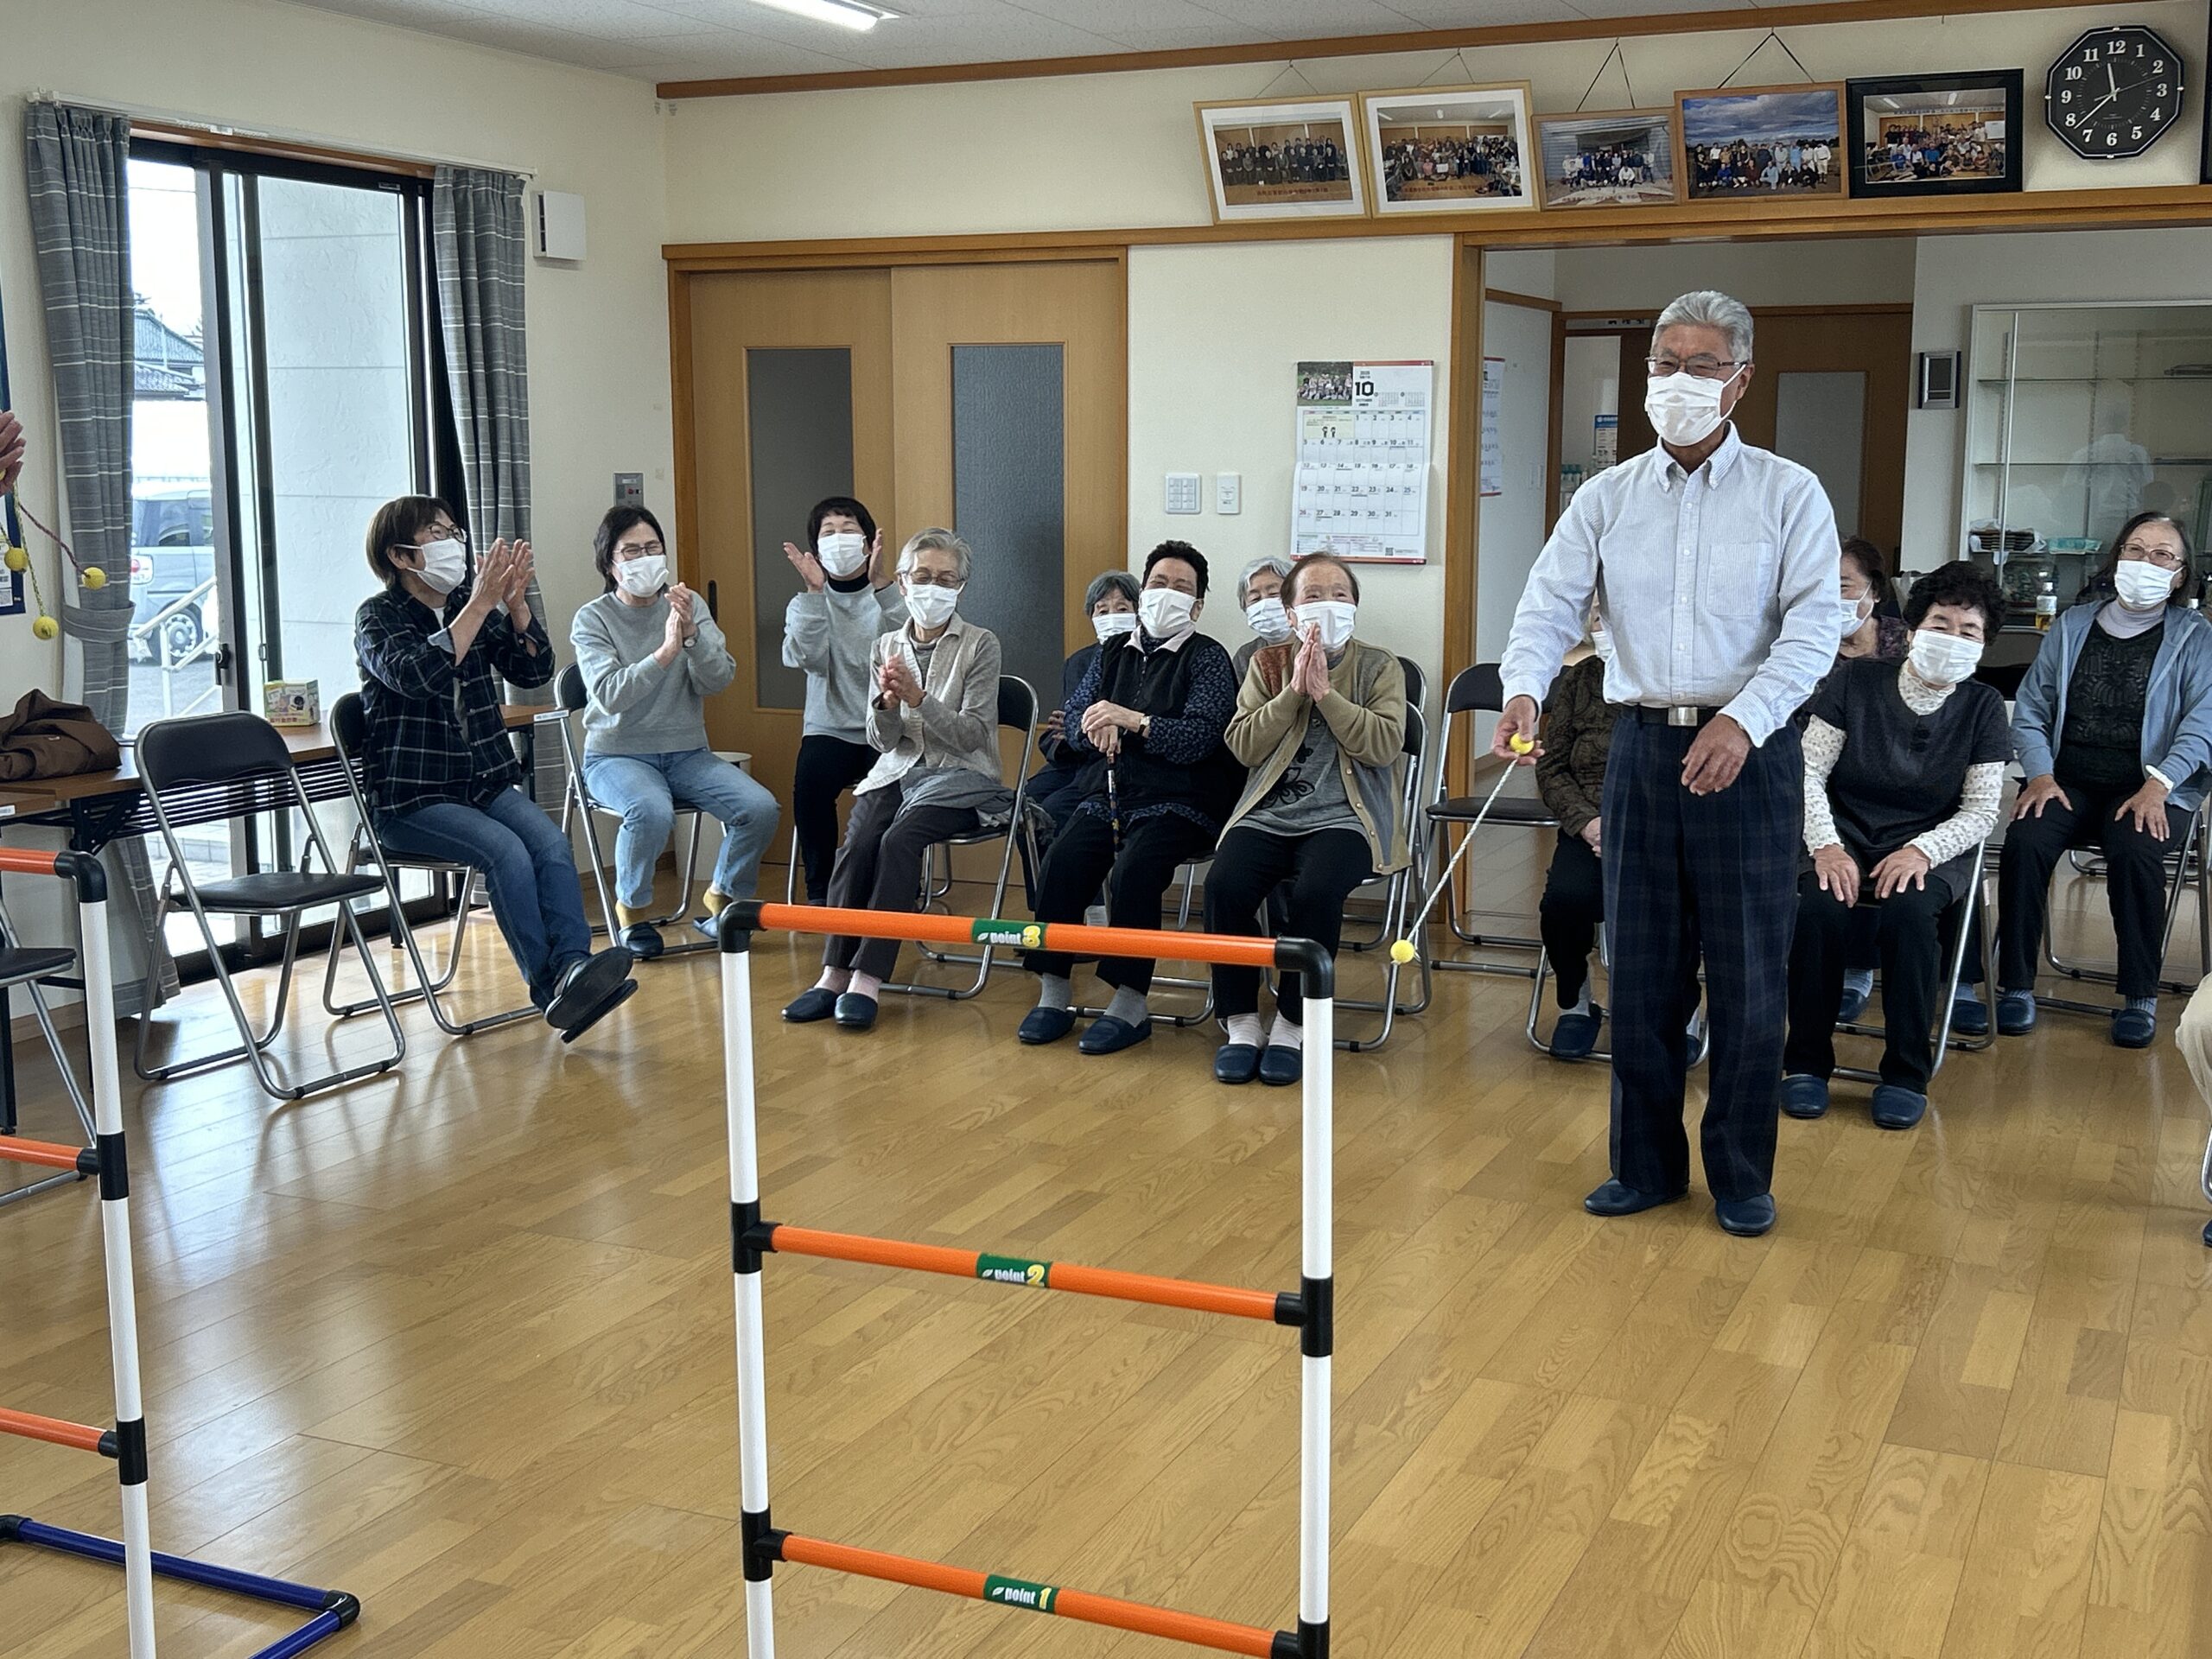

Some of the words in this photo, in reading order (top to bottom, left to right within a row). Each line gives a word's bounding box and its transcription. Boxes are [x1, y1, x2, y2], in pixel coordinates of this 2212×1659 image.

[2107, 41, 2126, 54] 12
[2136, 44, 2145, 57] 1
[2083, 48, 2100, 62] 11
[2152, 60, 2164, 73] 2
[2065, 67, 2082, 80] 10
[2157, 84, 2167, 97] 3
[2062, 91, 2072, 104] 9
[2065, 113, 2076, 127] 8
[2150, 108, 2161, 121] 4
[2082, 130, 2094, 143] 7
[2107, 132, 2118, 146] 6
[2132, 126, 2142, 139] 5
[1355, 381, 1374, 397] 10
[990, 931, 1022, 944] point
[1022, 925, 1041, 948] 3
[995, 1268, 1026, 1282] point
[1027, 1264, 1046, 1287] 2
[1005, 1587, 1036, 1605] point
[1039, 1587, 1052, 1610] 1
